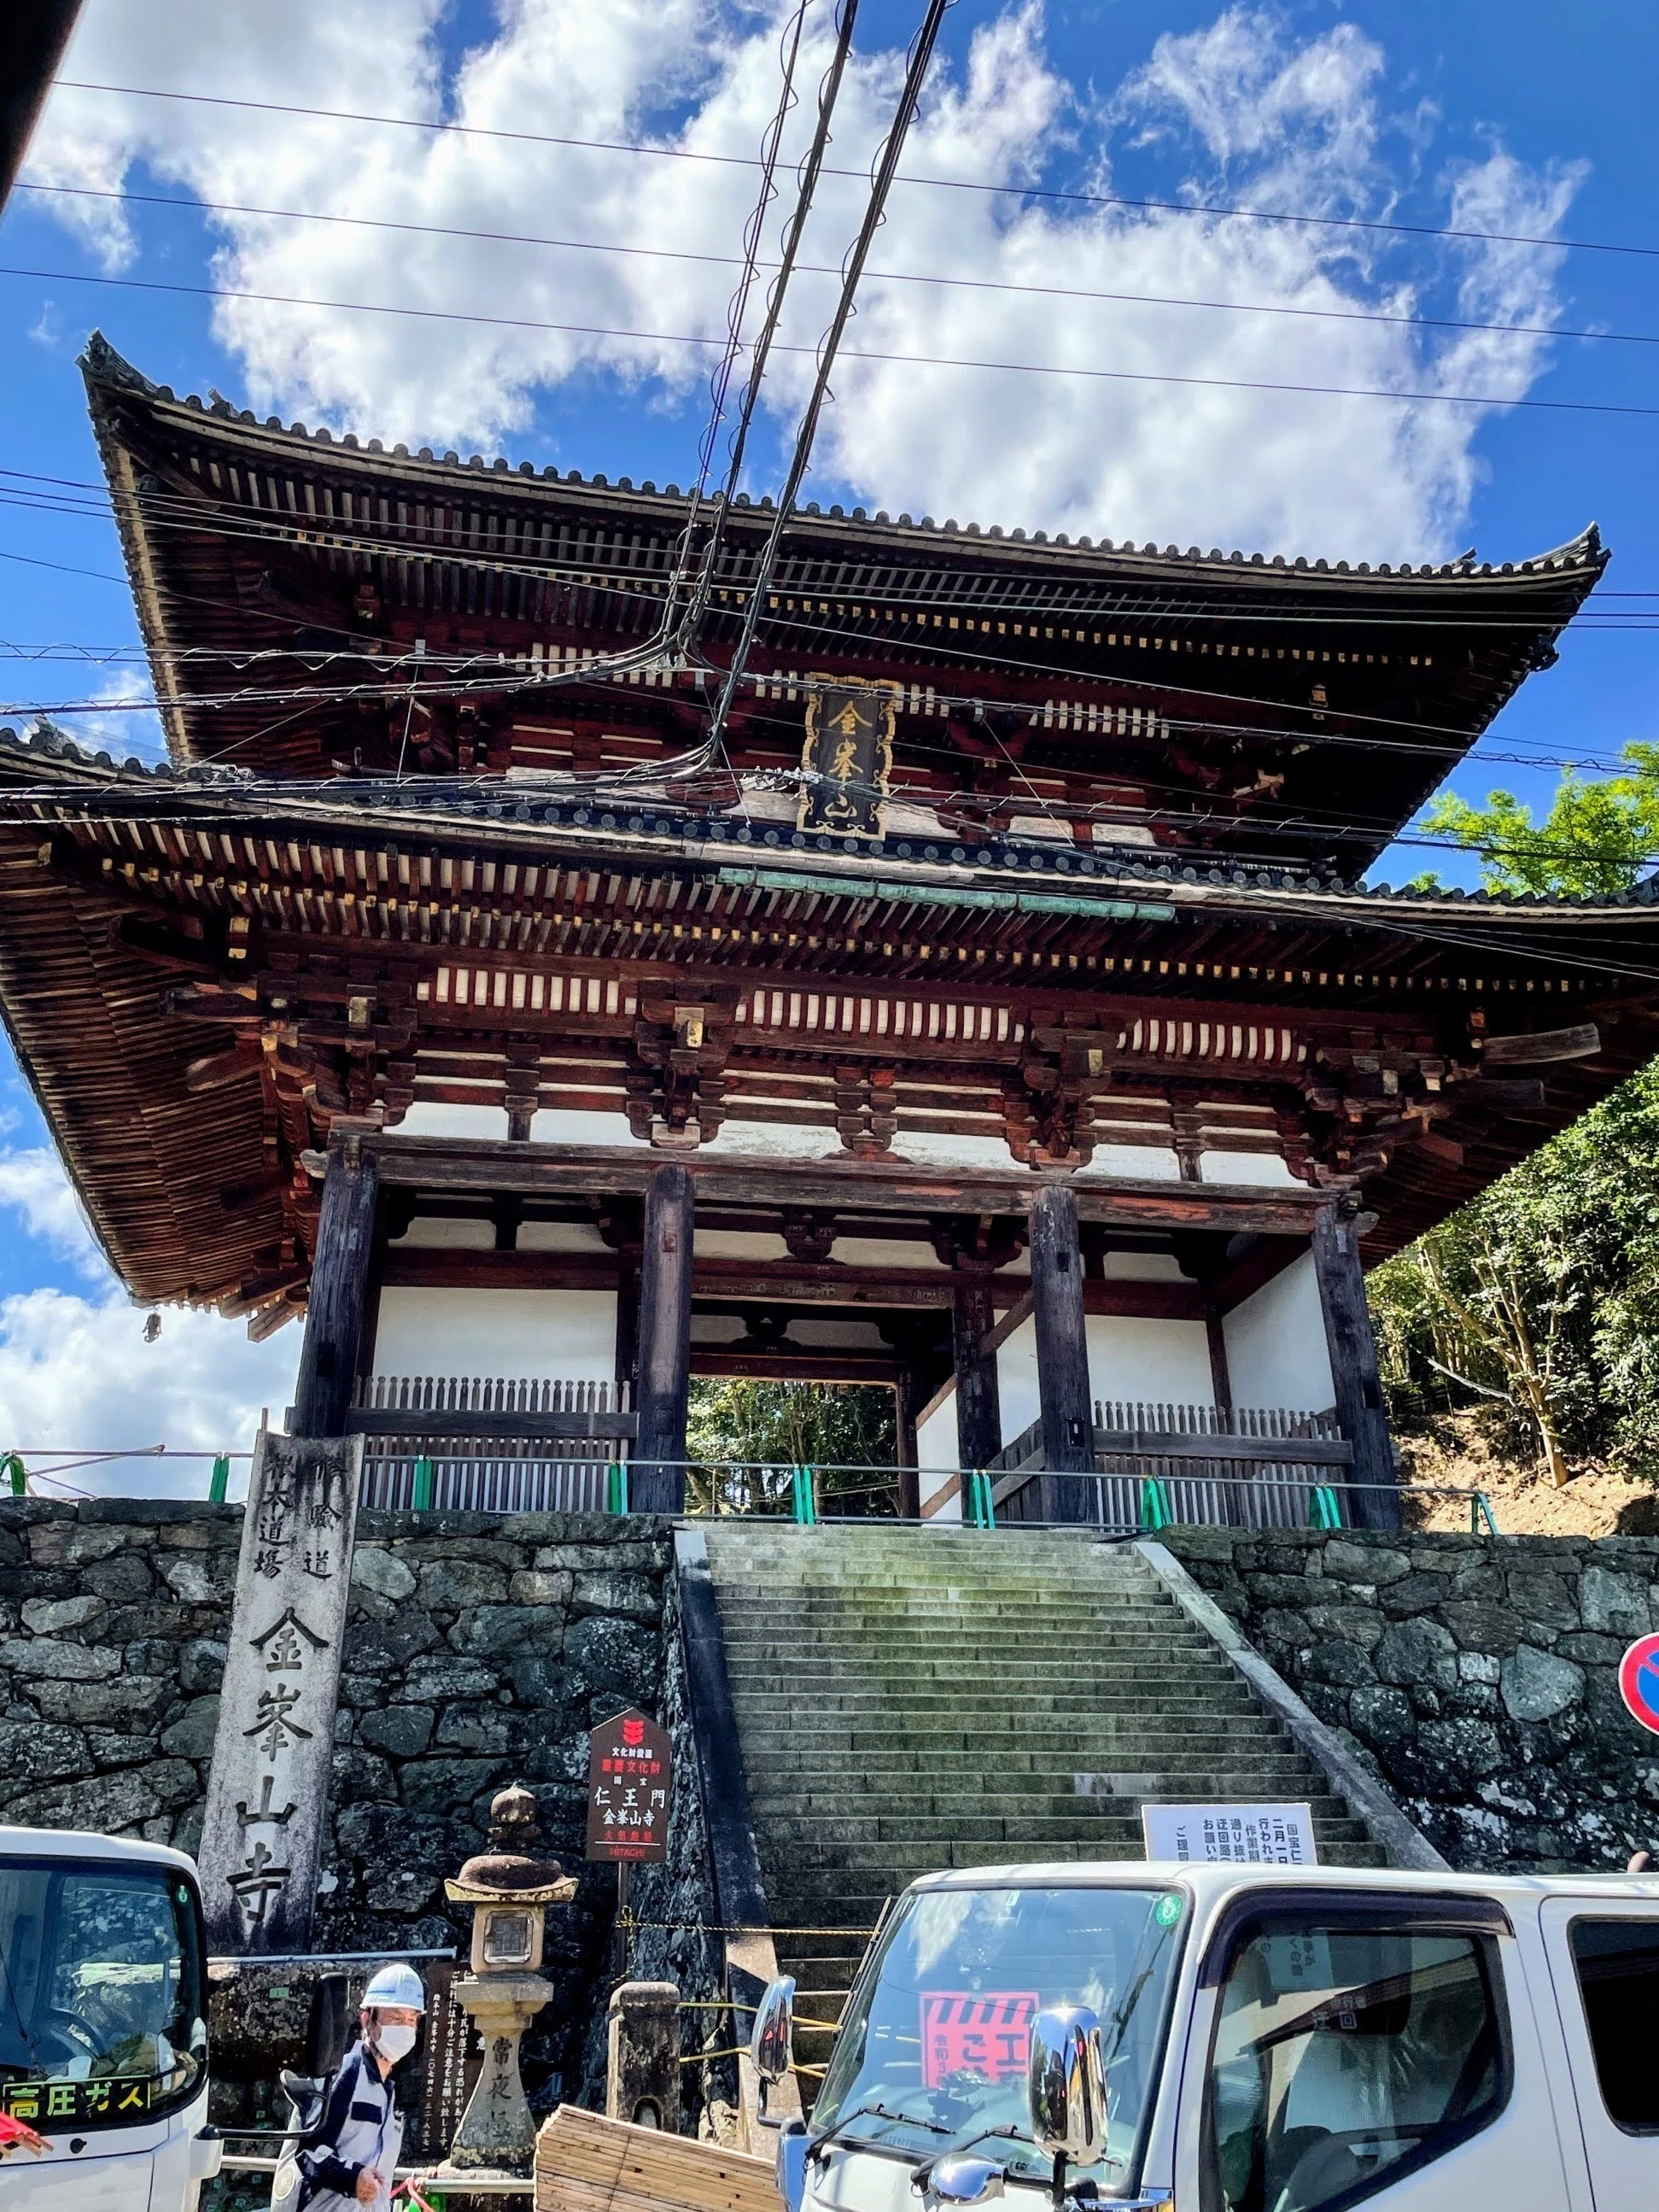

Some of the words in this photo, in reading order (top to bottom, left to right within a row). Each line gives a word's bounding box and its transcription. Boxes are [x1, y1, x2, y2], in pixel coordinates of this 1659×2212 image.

[225, 1606, 330, 1922] 金峯山寺
[594, 1786, 666, 1809] 仁王門
[602, 1807, 656, 1828] 金峯山寺
[1287, 1824, 1303, 1864] 国宝仁
[9, 2081, 144, 2120] 高圧ガス
